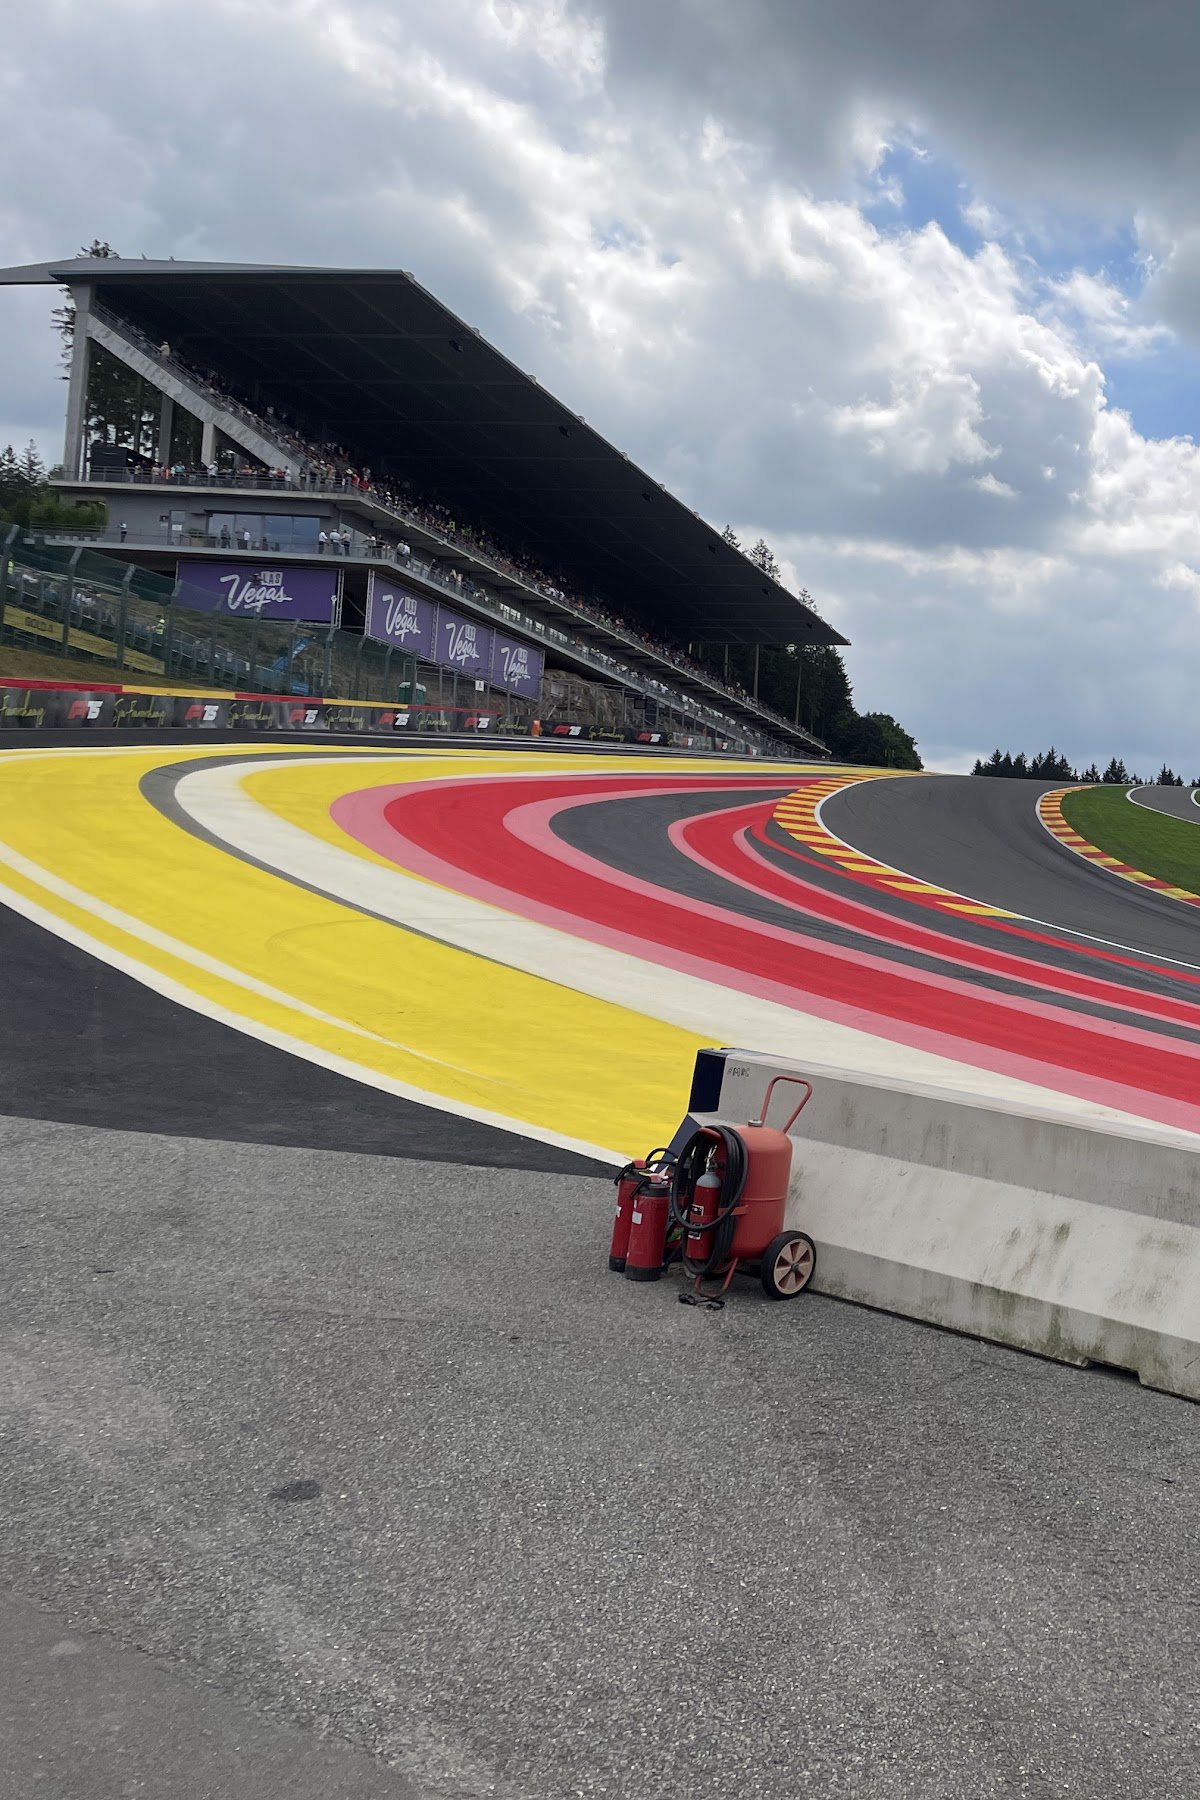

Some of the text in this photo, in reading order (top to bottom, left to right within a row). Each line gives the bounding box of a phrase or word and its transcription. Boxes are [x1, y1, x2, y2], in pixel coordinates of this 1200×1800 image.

[220, 574, 293, 613] Vegas
[262, 572, 282, 585] LAS
[382, 595, 421, 642] Vegas
[445, 623, 480, 666] Vegas
[501, 647, 531, 687] Vegas
